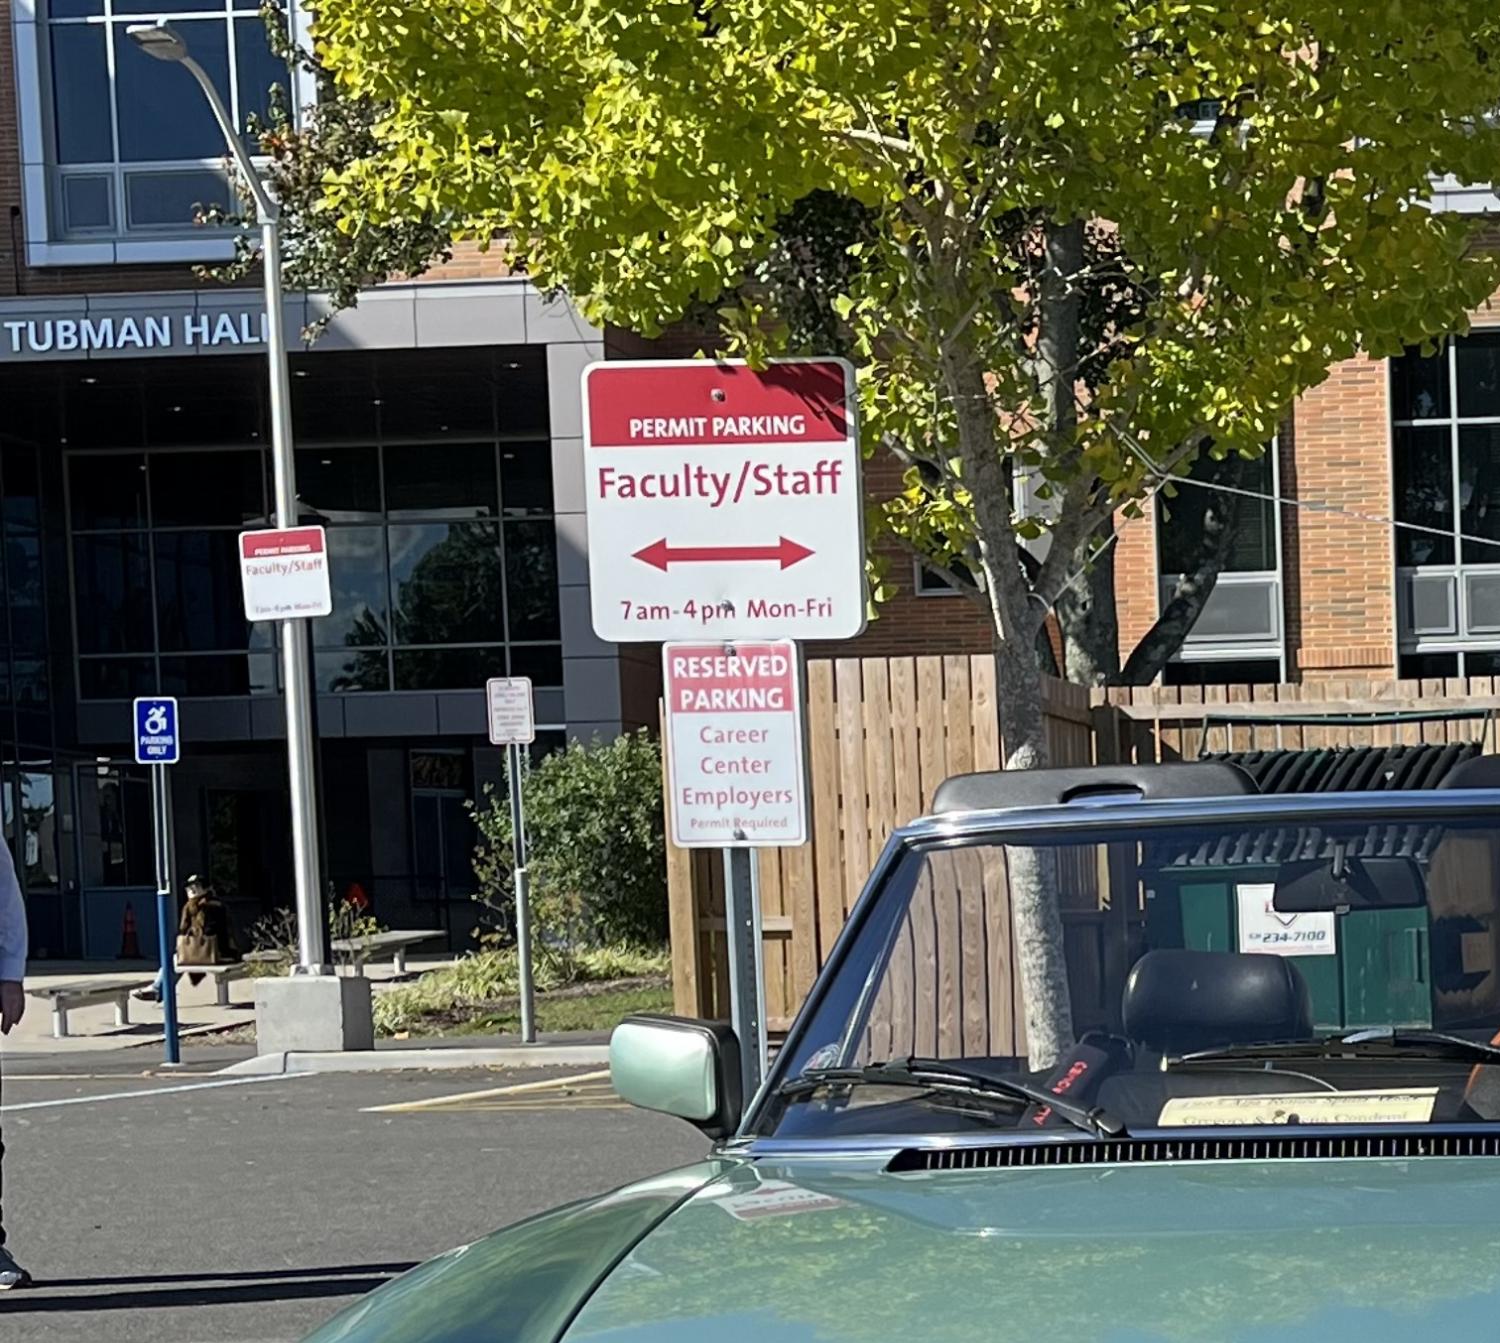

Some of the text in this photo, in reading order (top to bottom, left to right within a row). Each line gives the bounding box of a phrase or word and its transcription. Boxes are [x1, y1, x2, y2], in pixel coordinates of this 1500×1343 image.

[3, 315, 171, 352] TUBMAN
[629, 415, 806, 438] PERMIT PARKING
[599, 460, 842, 508] Faculty/Staff
[746, 597, 833, 619] Mon-Fri
[673, 655, 789, 678] RESERVED
[680, 687, 784, 710] PARKING
[699, 725, 769, 744] Career
[700, 756, 772, 774] Center
[682, 786, 793, 810] Employers
